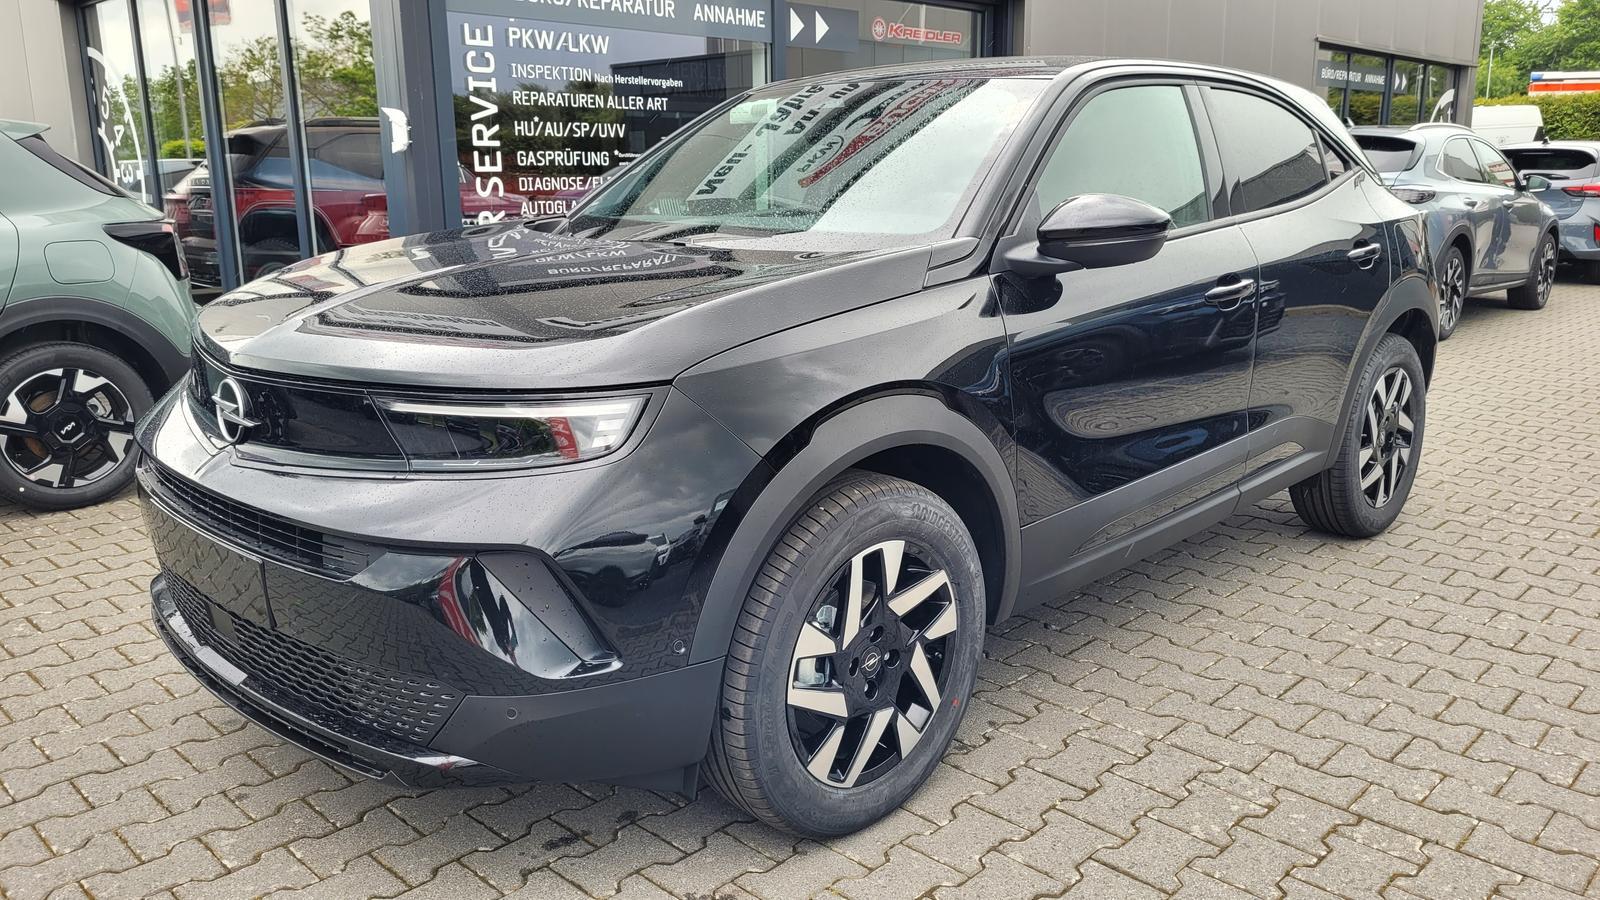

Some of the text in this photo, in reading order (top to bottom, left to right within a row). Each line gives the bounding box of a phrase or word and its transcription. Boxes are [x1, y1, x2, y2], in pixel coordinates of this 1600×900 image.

[514, 0, 766, 28] REPARATUR ANNAHME
[508, 27, 610, 55] PKW/LKW
[887, 22, 962, 44] KREDLER
[511, 63, 593, 83] INSPEKTION
[594, 73, 614, 84] Nach
[614, 74, 684, 89] Herstellervorgaben
[1321, 66, 1362, 82] BÜRO/REPAATUR
[463, 22, 505, 198] SERVICE
[512, 90, 668, 112] REPARATUREN ALLER ART
[517, 149, 610, 167] GASPRÜFUNG
